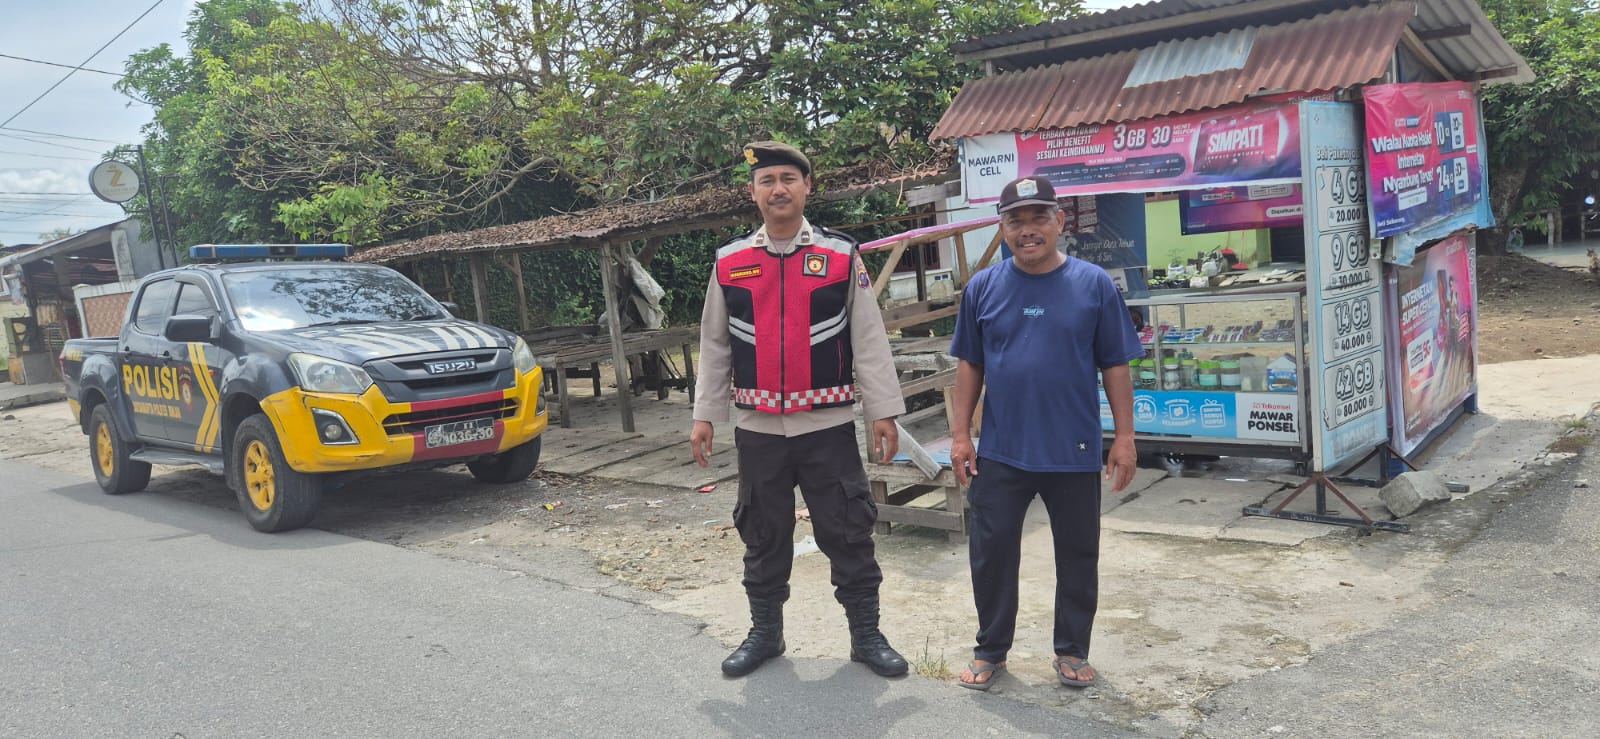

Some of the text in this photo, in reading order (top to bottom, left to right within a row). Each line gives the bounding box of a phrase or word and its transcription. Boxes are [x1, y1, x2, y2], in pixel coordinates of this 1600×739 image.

[1046, 135, 1092, 149] PILIH BENEFIT
[1151, 125, 1171, 145] 30
[1207, 124, 1264, 154] SIMPATI
[1434, 121, 1445, 146] 10
[967, 151, 1015, 168] MAWARNI
[1036, 144, 1105, 161] SESUAI KEINGINANMU
[979, 162, 1002, 177] CELL
[1331, 168, 1344, 204] 4
[1336, 208, 1361, 223] 20.000
[1331, 232, 1369, 271] 9 GB
[1340, 333, 1365, 351] 40.000
[430, 360, 475, 374] ISUZU
[122, 364, 180, 401] POLISI
[1335, 358, 1374, 401] 42 GB
[1249, 410, 1294, 422] MAWAR
[1343, 396, 1368, 418] 80.000
[1247, 420, 1297, 433] PONSEL
